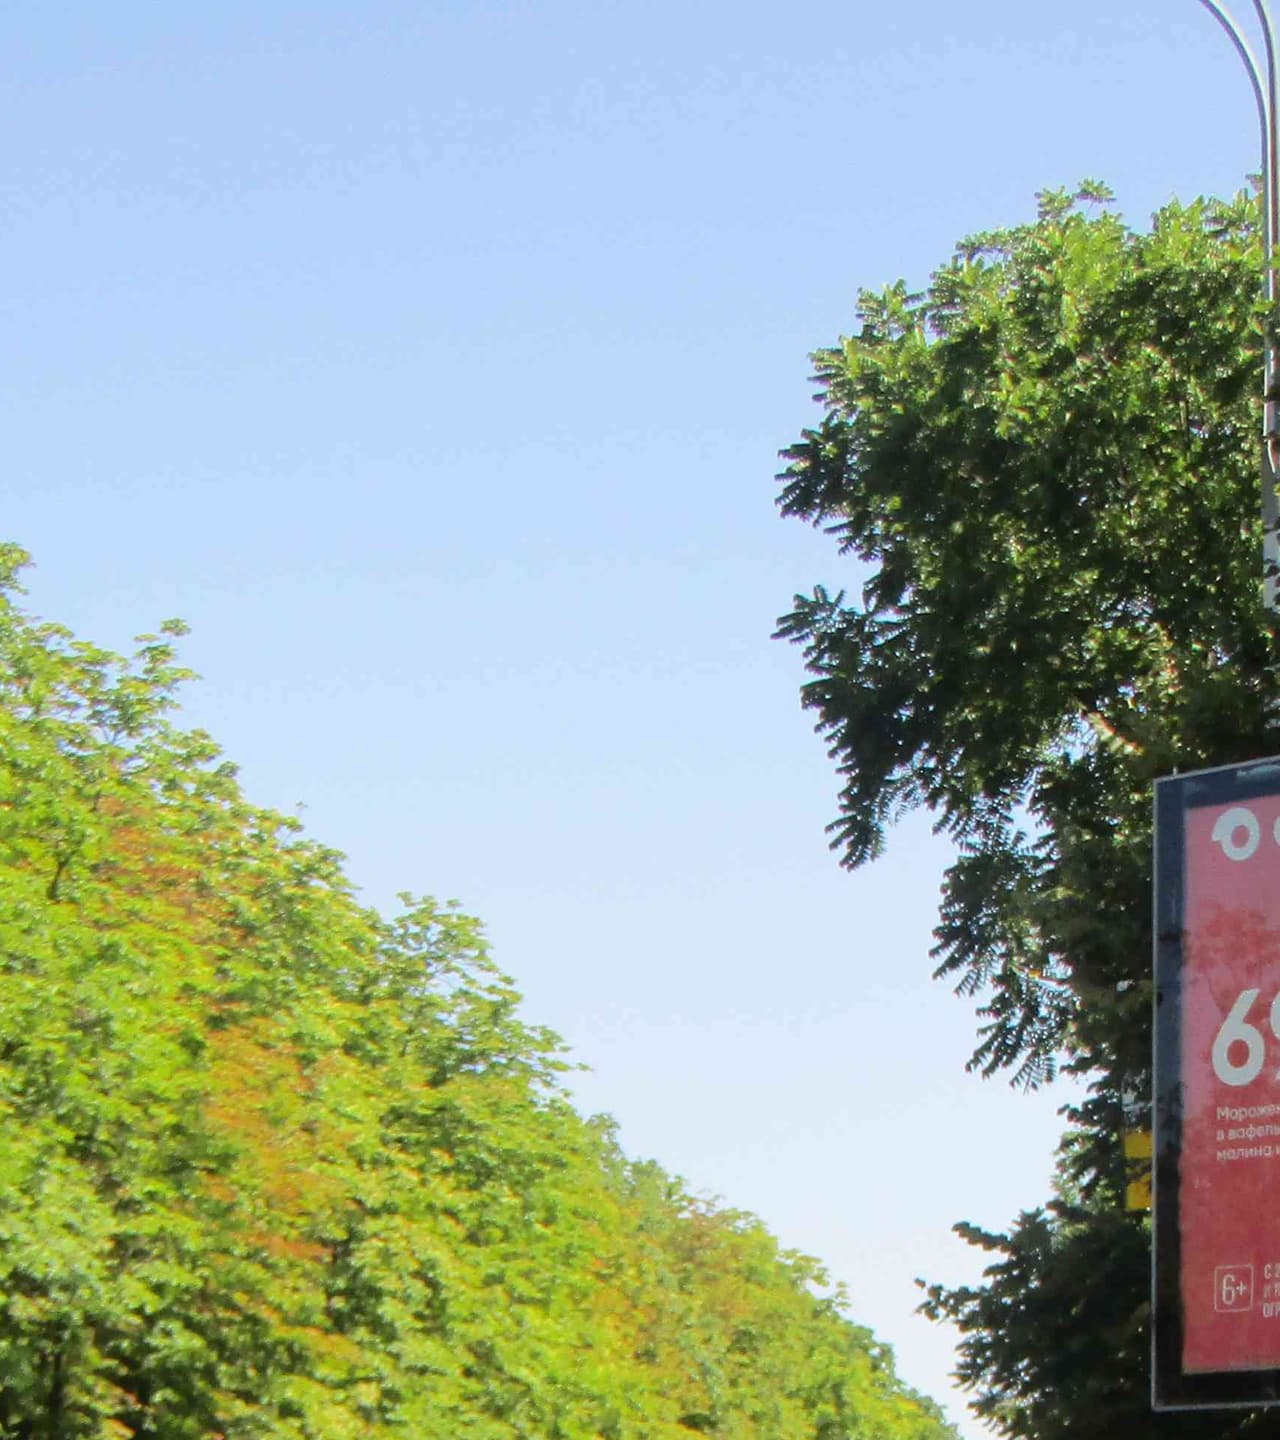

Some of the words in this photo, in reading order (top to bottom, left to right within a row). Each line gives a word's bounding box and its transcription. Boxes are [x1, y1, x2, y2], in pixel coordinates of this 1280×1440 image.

[1216, 1129, 1225, 1141] в
[1216, 1145, 1273, 1162] малина
[1222, 1273, 1247, 1306] 6+
